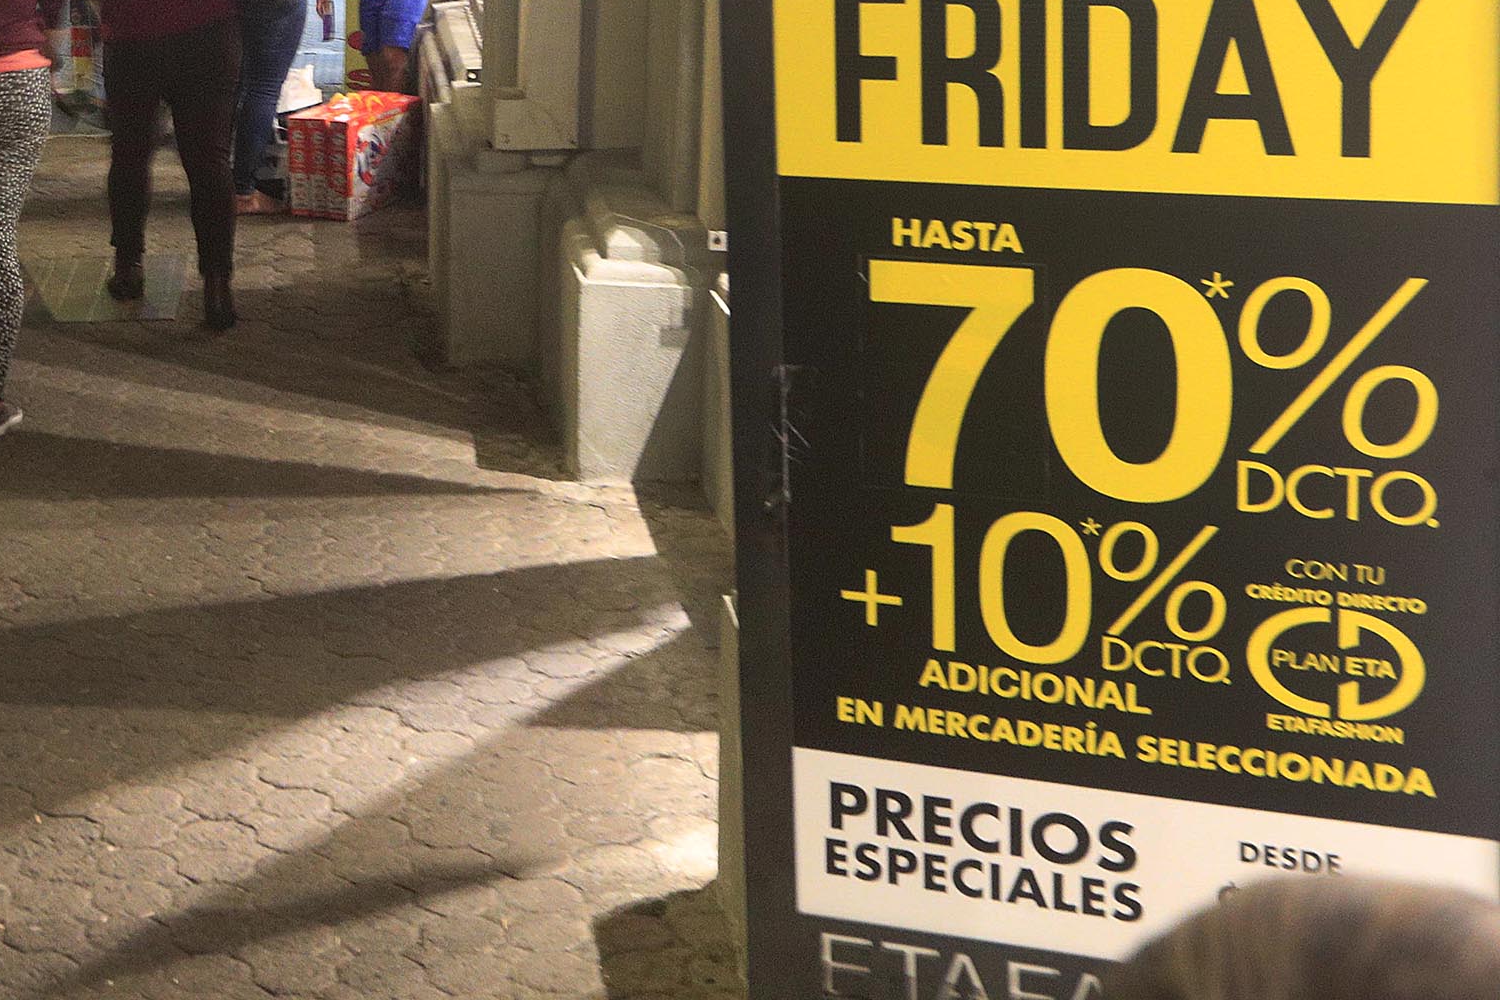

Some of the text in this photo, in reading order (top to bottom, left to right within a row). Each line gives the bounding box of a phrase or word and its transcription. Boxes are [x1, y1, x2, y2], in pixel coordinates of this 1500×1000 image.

[891, 217, 1024, 254] HASTA
[1284, 557, 1387, 585] CON TU
[1244, 581, 1429, 616] CRÉDITO DIRECTO
[1271, 648, 1399, 681] PLAN ETA
[919, 659, 1152, 716] ADICIONAL
[1265, 712, 1406, 745] ETAFASHION
[836, 696, 1438, 799] EN MERCADERÍA SELECCIONADA
[828, 780, 1138, 875] PRECIOS
[824, 836, 1145, 923] ESPECIALES
